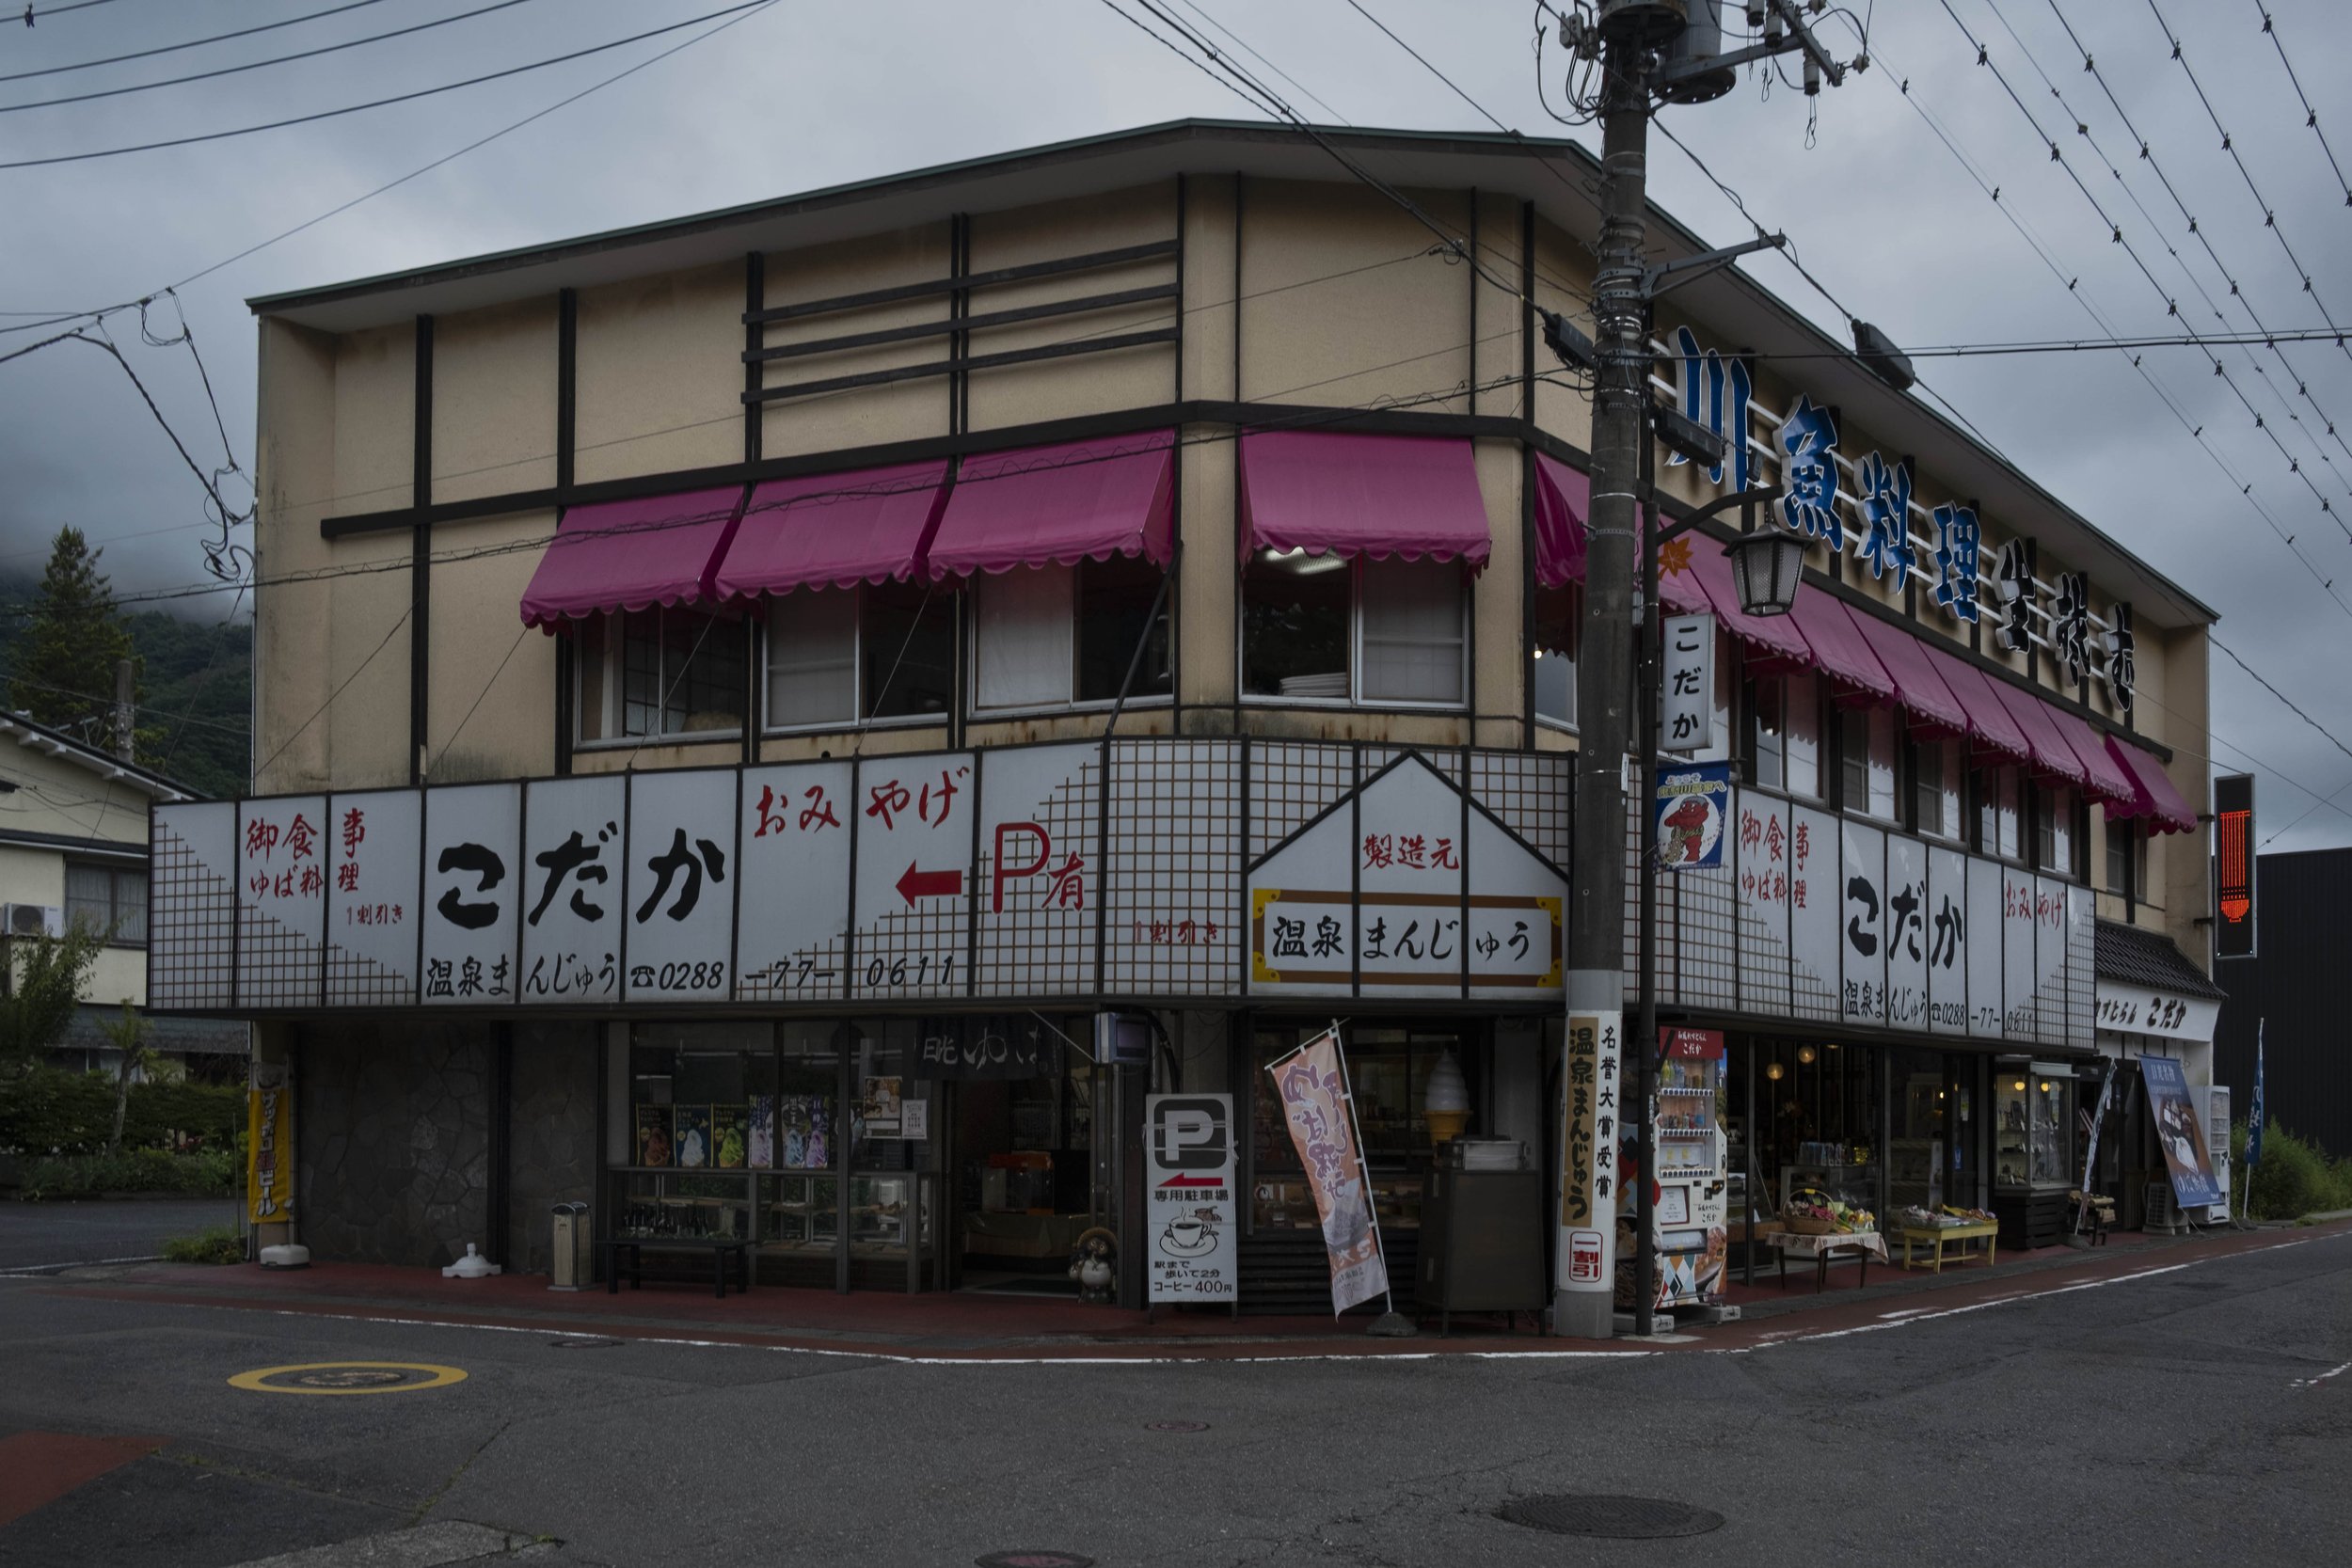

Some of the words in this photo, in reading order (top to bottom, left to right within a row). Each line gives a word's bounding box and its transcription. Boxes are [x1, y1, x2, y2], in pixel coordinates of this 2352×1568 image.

[1664, 325, 1981, 624] 川魚料理
[1672, 625, 1702, 740] こだか
[754, 766, 970, 837] おみやげ
[246, 806, 366, 864] 御食事
[1362, 832, 1460, 871] 製造元
[249, 862, 359, 900] ゆば料理
[436, 820, 725, 929] こだか
[1740, 864, 1808, 911] ゆば料理
[346, 902, 405, 927] 1割引き
[1847, 875, 1963, 970] こだか
[2005, 878, 2066, 931] おみやげ
[1134, 918, 1220, 946] 1割引き
[1272, 914, 1533, 962] 温泉まんじゅう
[425, 951, 618, 998] 温泉まんじゅう
[1844, 978, 1928, 1026] 温泉まんじゅう
[2147, 996, 2187, 1030] こだか
[1682, 1041, 1702, 1056] こだか
[1164, 1109, 1215, 1162] P
[1568, 1027, 1596, 1220] 温泉まんじゅう
[1596, 1025, 1616, 1200] 名誉大賞受賞
[1153, 1189, 1229, 1202] 専用駐車場
[1153, 1260, 1191, 1269] 駅まで
[1165, 1269, 1220, 1279] 歩いて2分
[1572, 1240, 1599, 1278] 一割引
[1153, 1281, 1193, 1293] コーヒー
[1195, 1280, 1232, 1293] 400円
